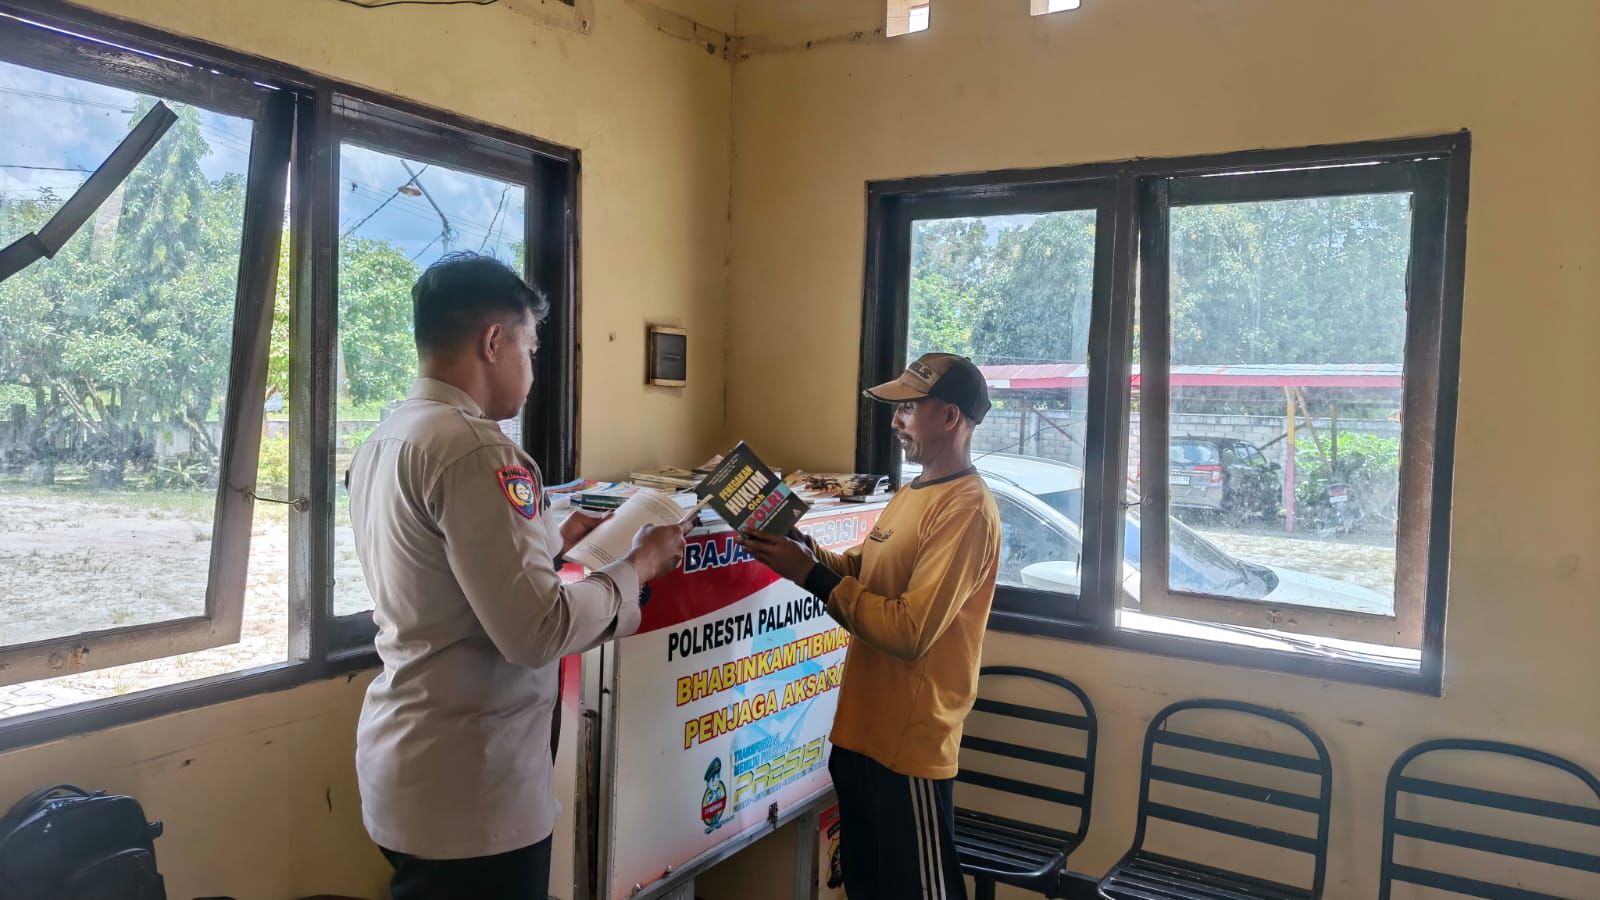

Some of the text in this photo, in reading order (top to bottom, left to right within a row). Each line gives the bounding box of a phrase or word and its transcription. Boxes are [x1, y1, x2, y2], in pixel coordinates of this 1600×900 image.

[719, 464, 754, 500] PENEGAKAN
[725, 470, 769, 517] HUKUM
[747, 494, 765, 511] Oleh
[684, 536, 754, 574] BAJA
[668, 612, 753, 662] POLRESTA
[684, 689, 778, 750] PENJAGA
[733, 735, 826, 805] PRESISI
